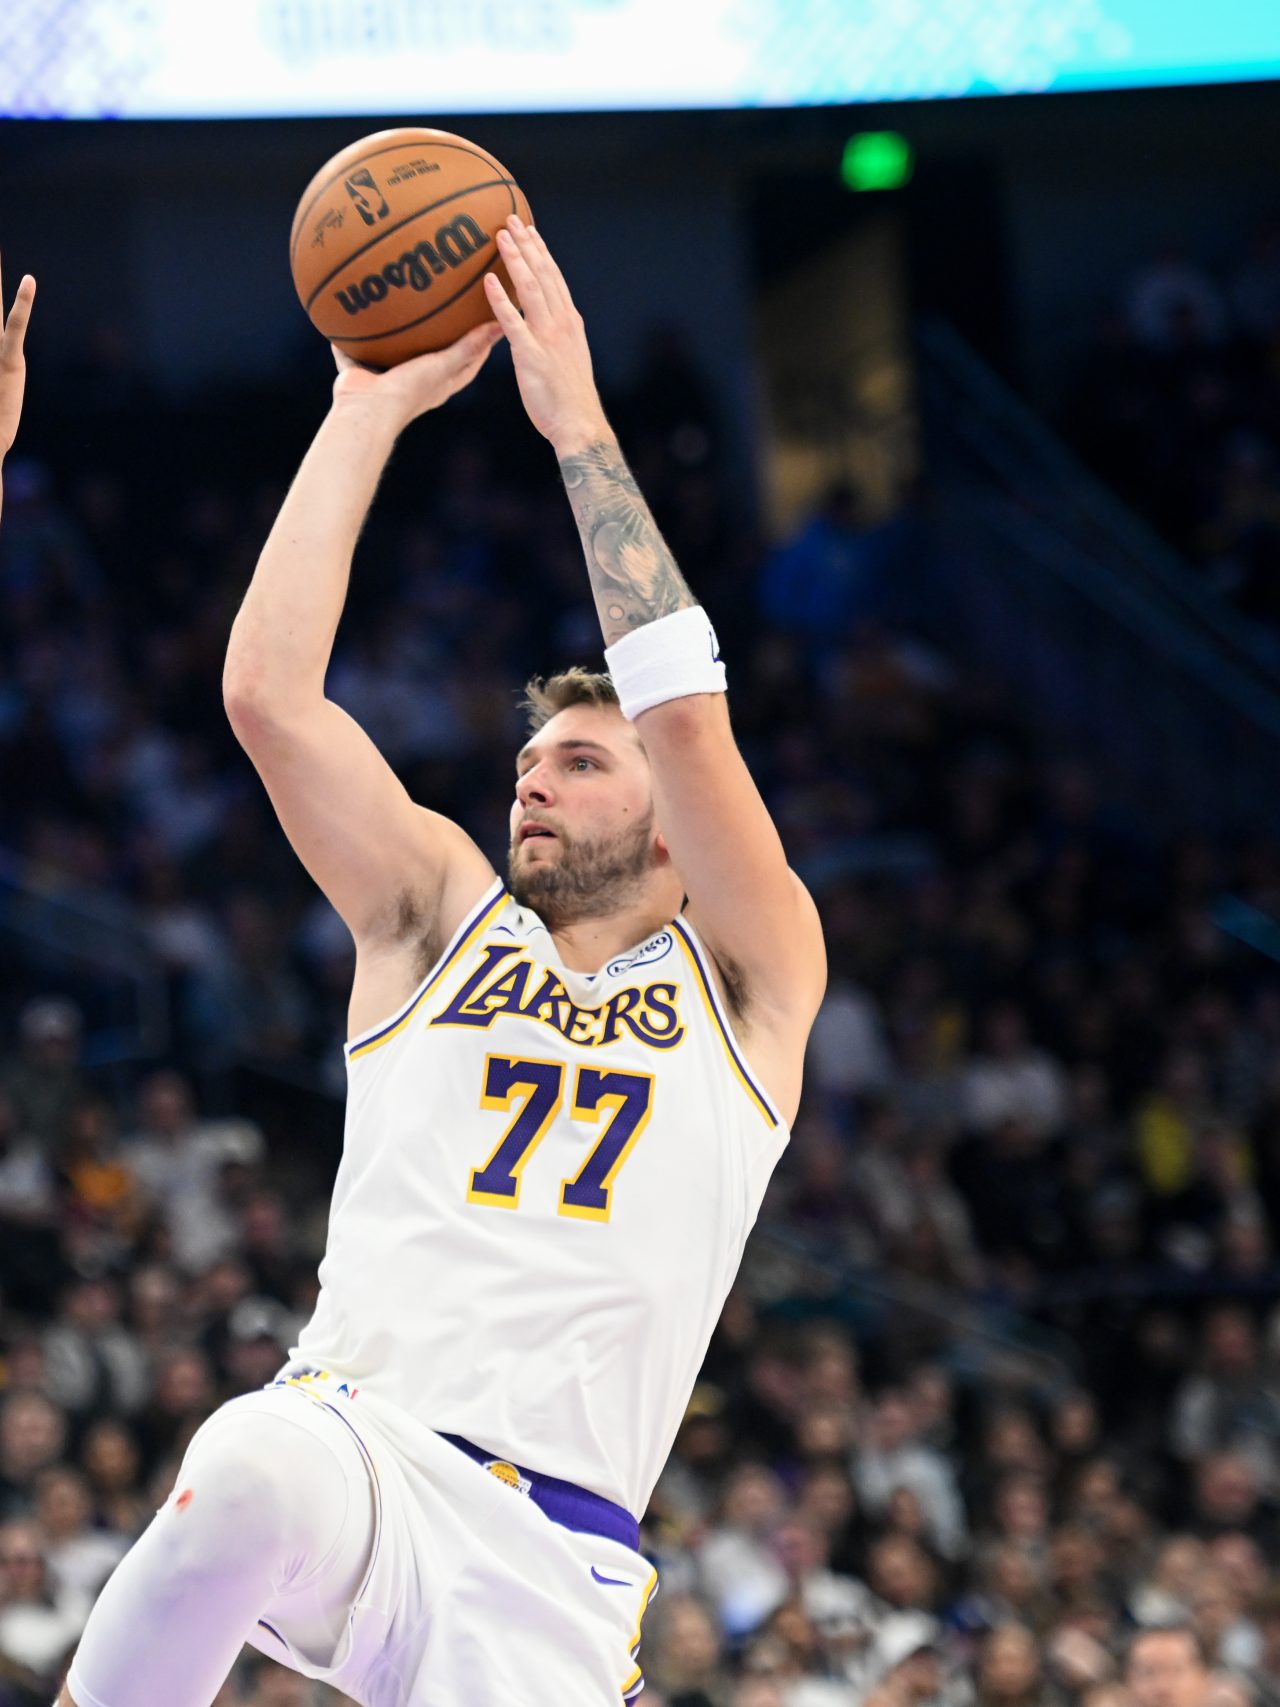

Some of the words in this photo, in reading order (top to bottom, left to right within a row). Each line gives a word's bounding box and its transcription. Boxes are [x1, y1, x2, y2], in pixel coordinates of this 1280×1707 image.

[333, 212, 491, 316] Wilson
[428, 944, 686, 1051] LAKERS
[466, 1052, 656, 1223] 77
